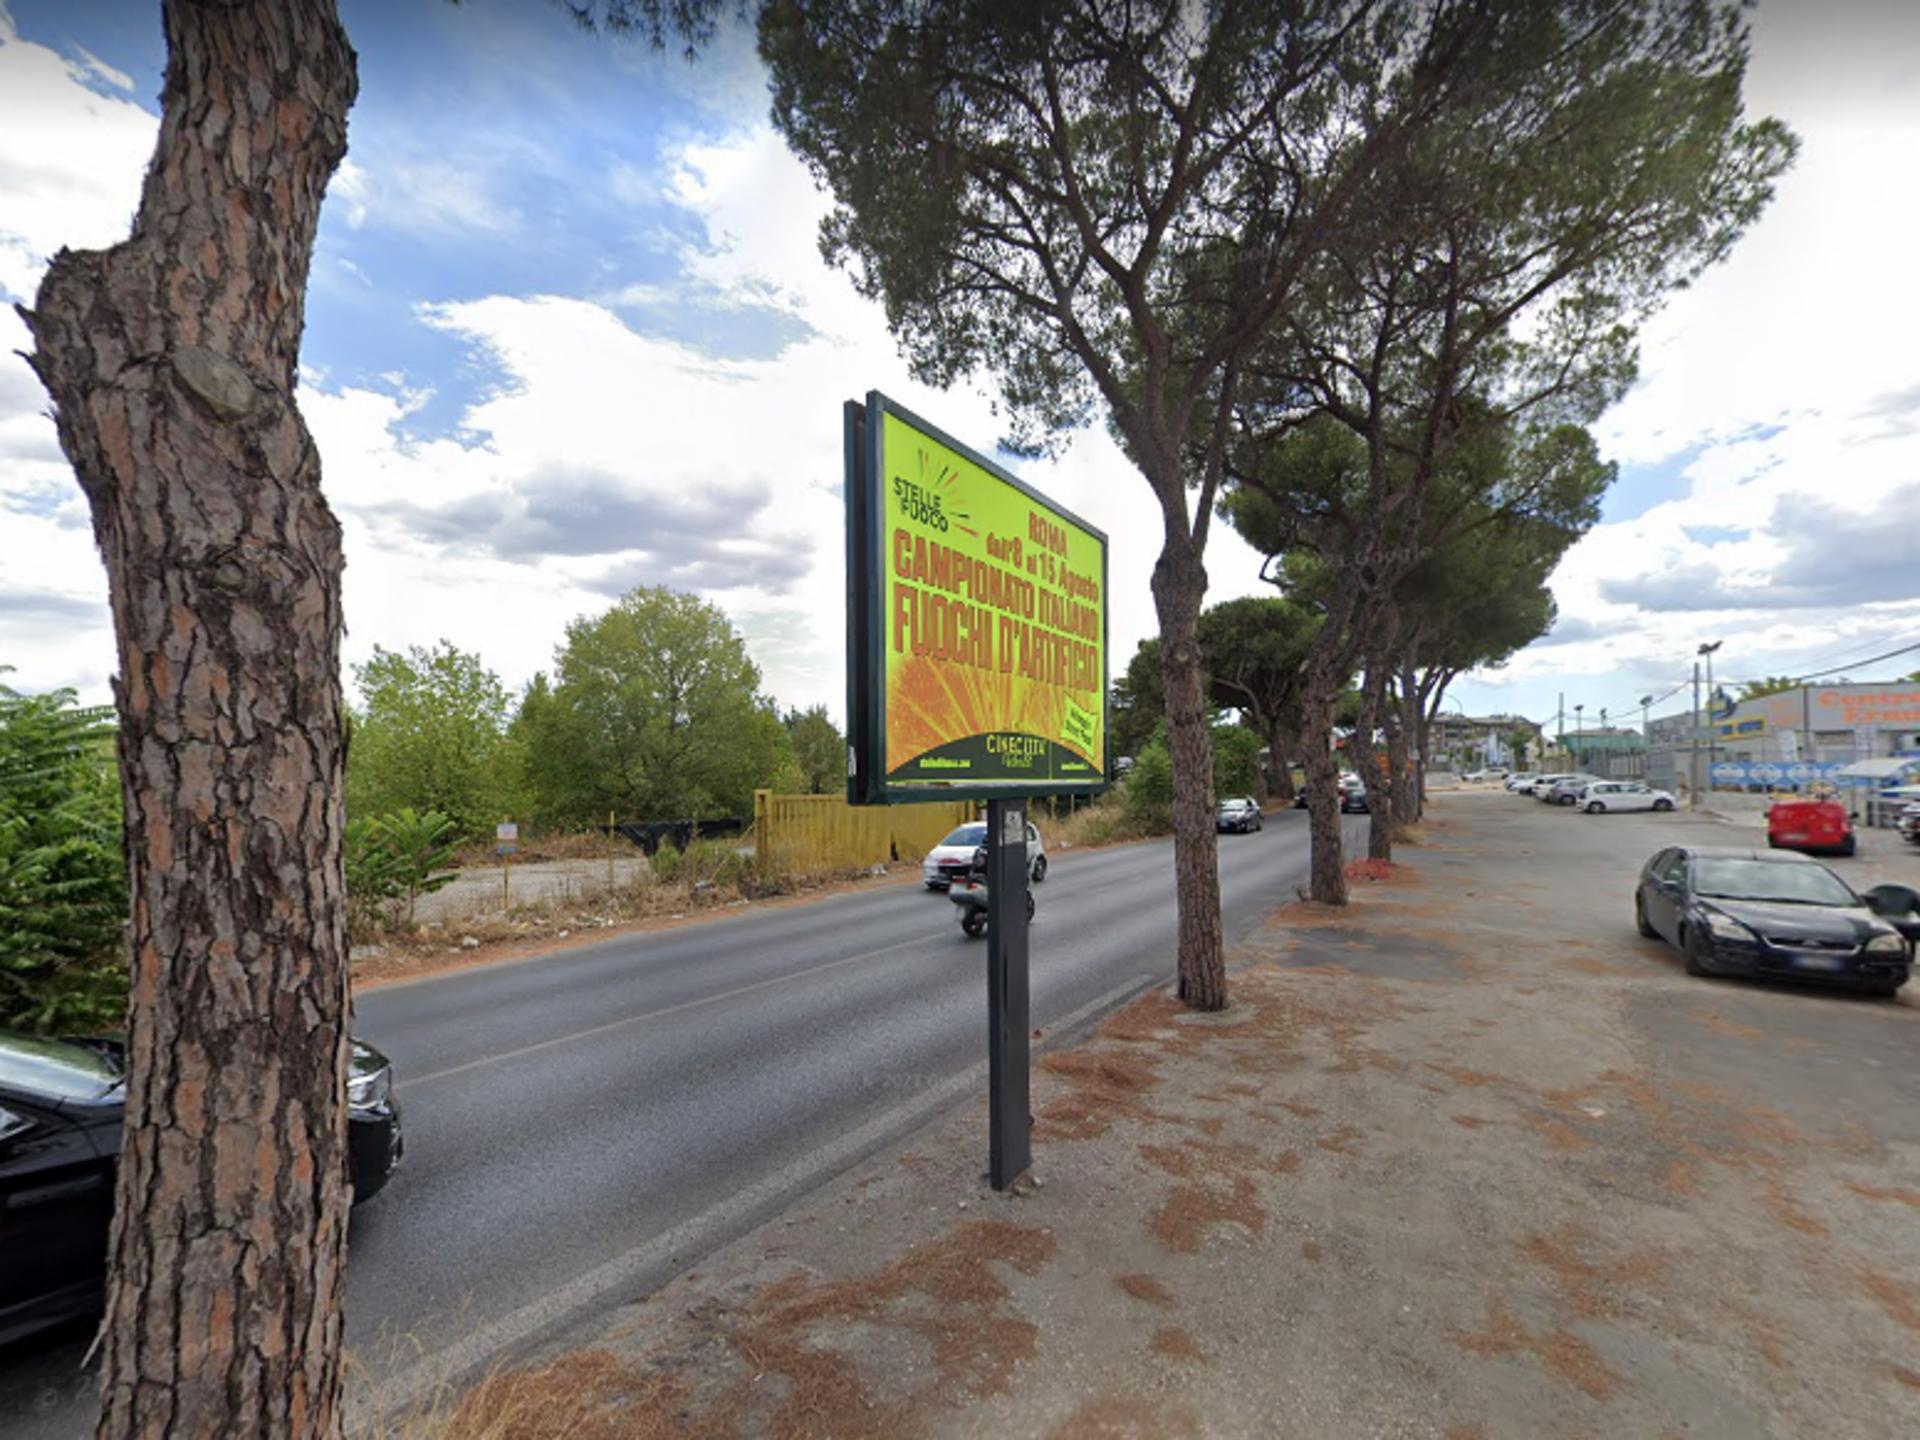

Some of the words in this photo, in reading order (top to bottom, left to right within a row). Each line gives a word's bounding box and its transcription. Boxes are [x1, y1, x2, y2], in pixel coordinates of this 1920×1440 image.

[894, 476, 941, 511] STELLE
[901, 498, 948, 533] FUOCO
[1028, 510, 1068, 561] ROMA
[894, 527, 1034, 619] CAMPIONATO
[1039, 586, 1099, 645] ITALIANO
[1039, 551, 1056, 585] 15
[893, 581, 992, 671] FUOCHI
[998, 615, 1098, 693] D'ARTIFICIO
